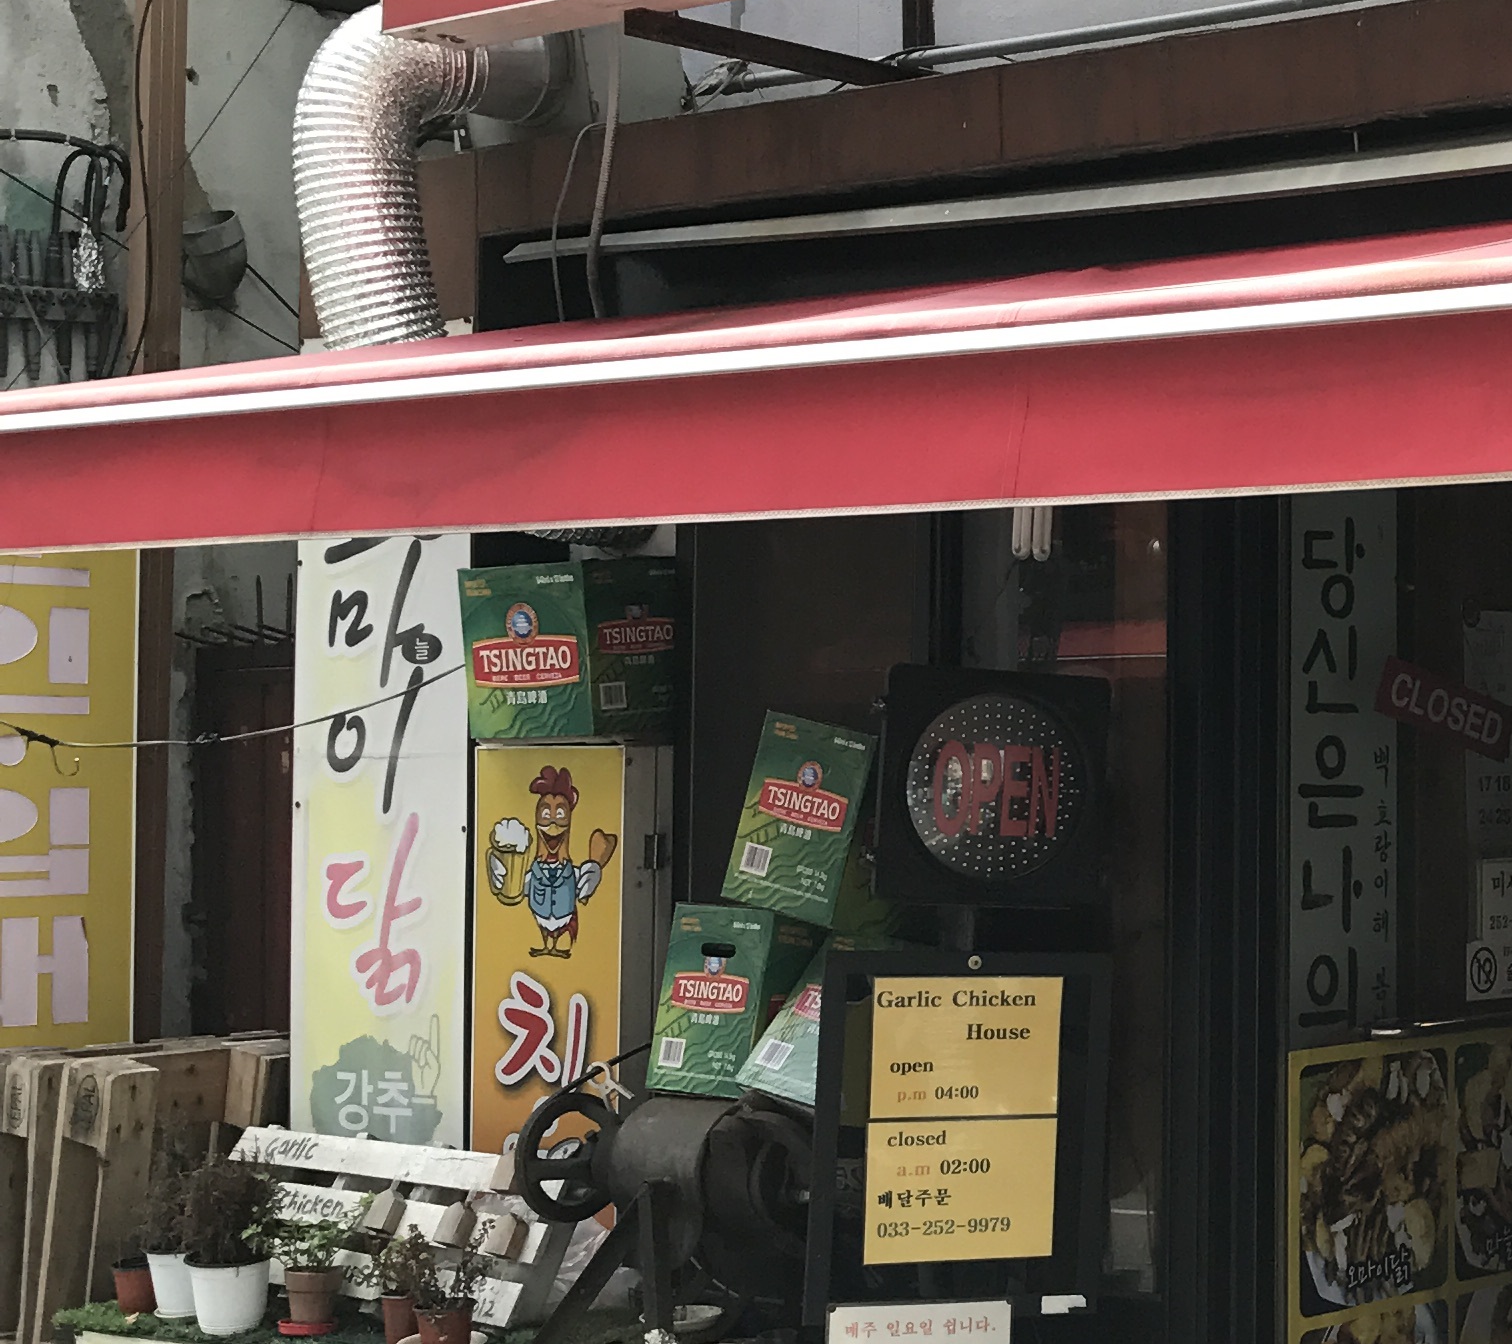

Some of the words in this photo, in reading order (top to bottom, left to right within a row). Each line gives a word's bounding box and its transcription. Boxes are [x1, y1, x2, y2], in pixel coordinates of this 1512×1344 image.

[603, 624, 674, 645] TSINGTAO
[480, 645, 571, 673] TSINGTAO
[1391, 672, 1500, 746] CLOSED
[935, 742, 1058, 839] OPEN
[767, 785, 840, 821] TSINGTAO
[679, 980, 743, 1002] TSINGTAO
[877, 989, 942, 1009] Garlic
[952, 989, 1037, 1008] Chicken
[966, 1023, 1030, 1042] House
[890, 1060, 934, 1077] open
[335, 1068, 414, 1137] 강추
[896, 1089, 927, 1104] p.m
[934, 1085, 979, 1101] 04:00
[887, 1130, 947, 1147] closed
[897, 1164, 930, 1177] a.m
[940, 1158, 991, 1175] 02:00
[877, 1188, 952, 1209] 배달주문
[877, 1217, 1012, 1239] 033-252-9979
[1347, 1248, 1411, 1289] 오마이닭
[886, 1319, 934, 1337] 일요일
[943, 1315, 996, 1336] 쉽니다.
